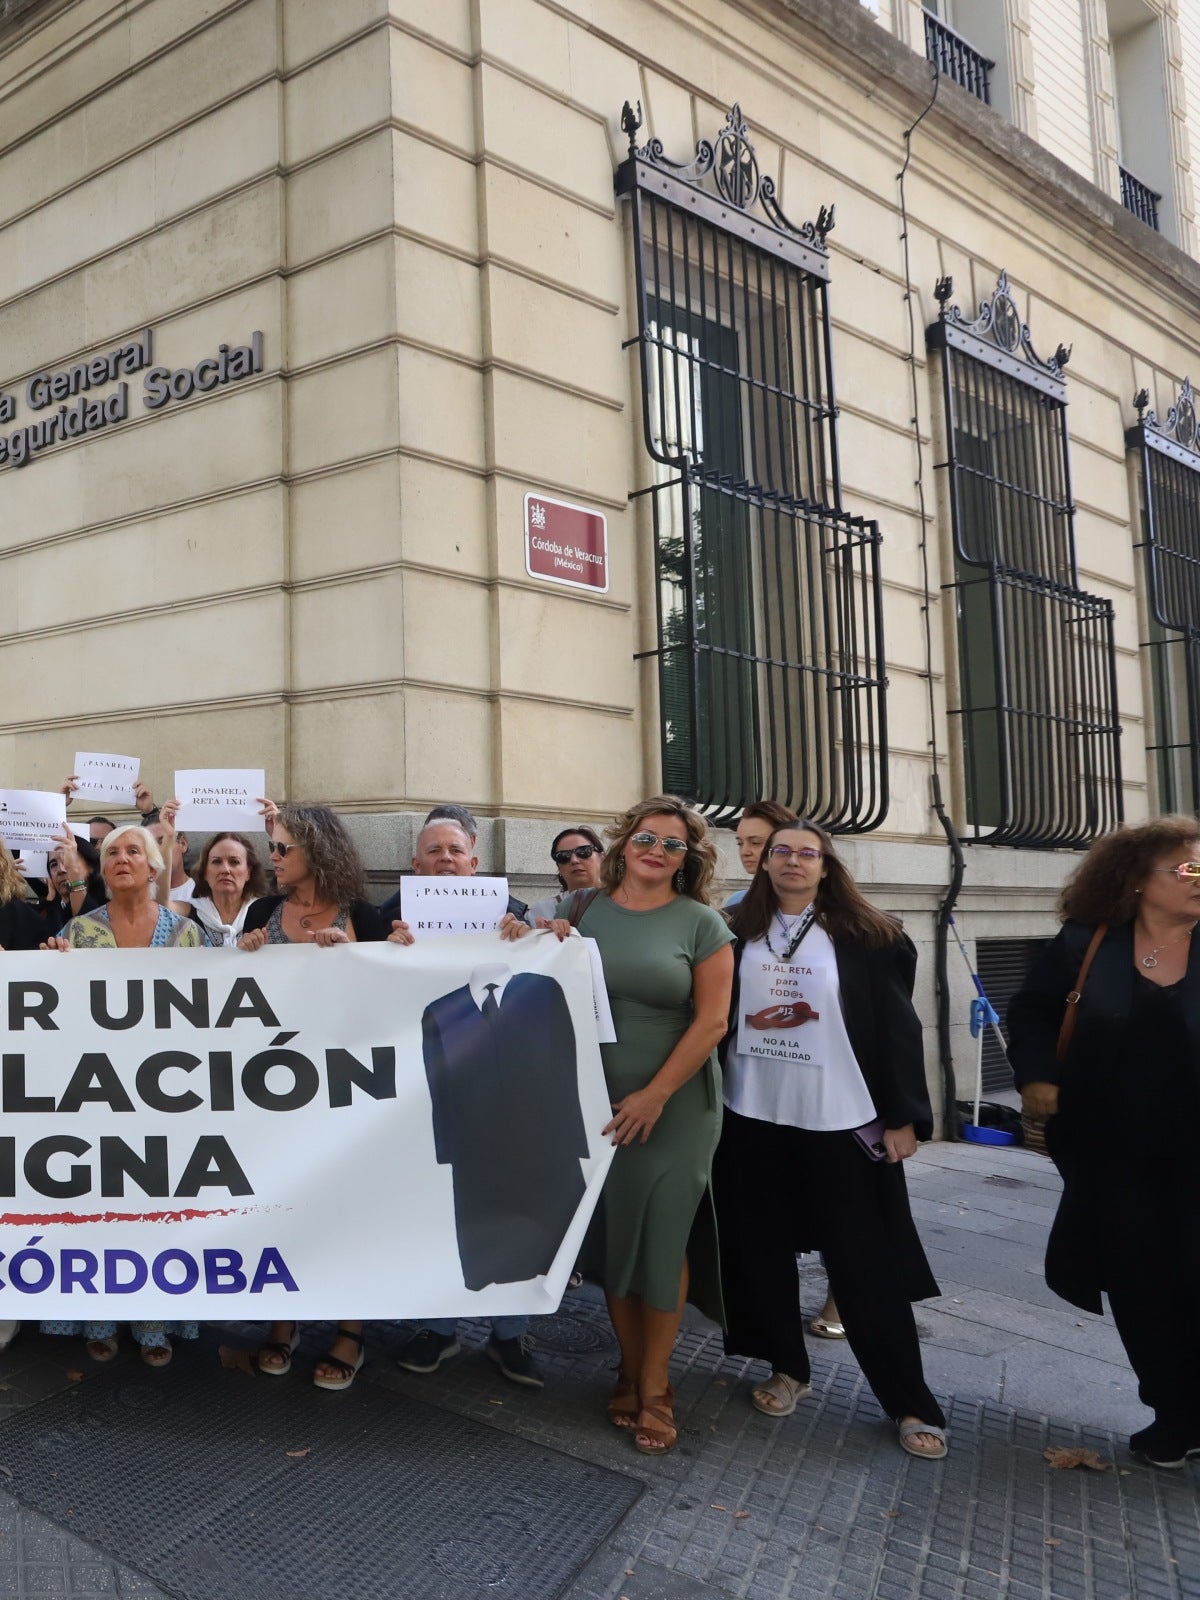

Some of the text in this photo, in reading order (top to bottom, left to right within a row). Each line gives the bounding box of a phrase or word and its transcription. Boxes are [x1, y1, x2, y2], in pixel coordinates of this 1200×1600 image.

[25, 328, 152, 410] General
[142, 330, 263, 408] Social
[531, 536, 604, 565] Córdoba de Veracruz
[554, 556, 584, 574] (México)
[191, 787, 248, 796] ¡PASARELA
[416, 888, 498, 897] ¡PASARELA
[418, 921, 453, 929] RETA
[773, 965, 786, 973] AL
[789, 966, 813, 975] RETA
[776, 978, 798, 986] para
[770, 989, 804, 999] TOD@s
[88, 977, 282, 1031] UNA
[778, 1006, 794, 1015] #J2
[763, 1037, 799, 1048] NO A LA
[750, 1046, 811, 1061] MUTUALIDAD
